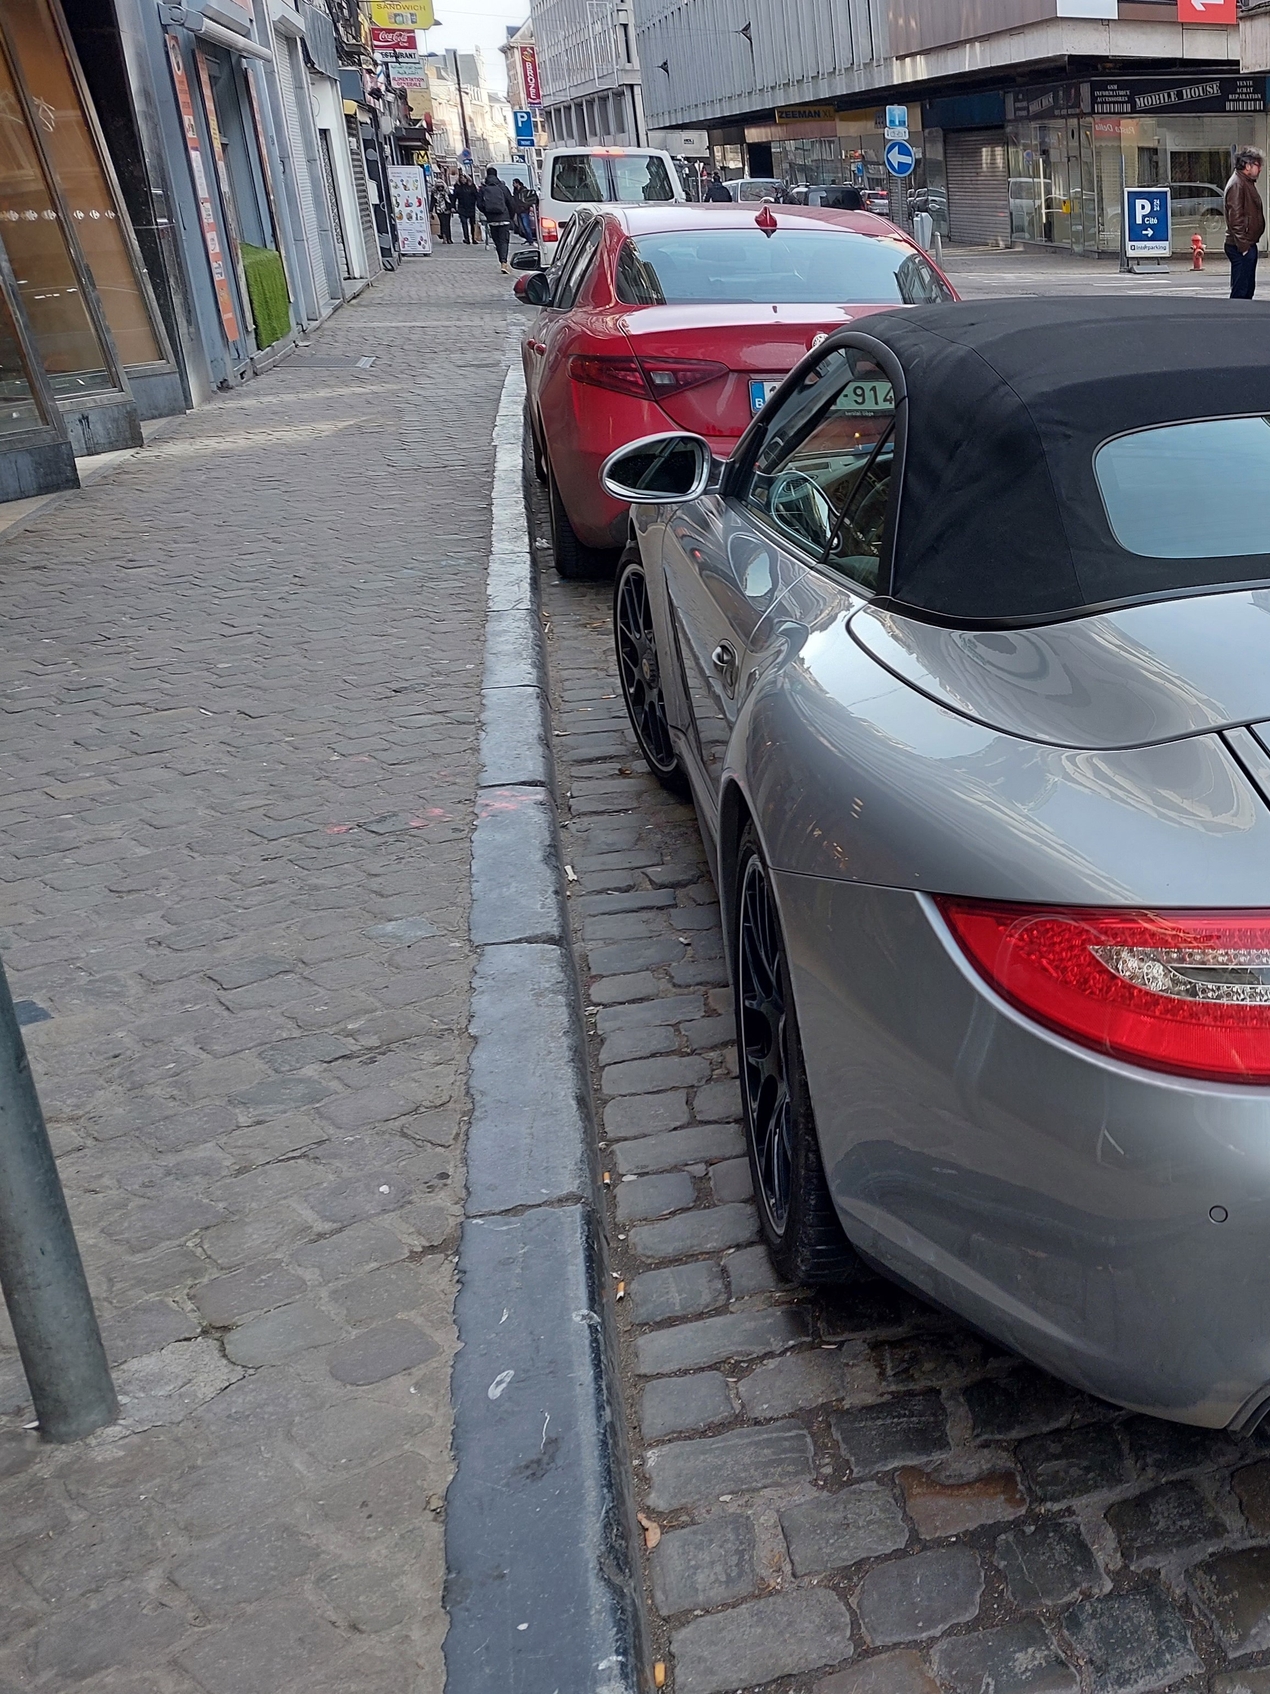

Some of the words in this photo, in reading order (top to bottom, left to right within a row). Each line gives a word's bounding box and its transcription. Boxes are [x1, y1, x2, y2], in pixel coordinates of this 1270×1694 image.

[376, 3, 426, 11] SANDWICH
[379, 30, 408, 42] Coca-Cola
[526, 62, 537, 99] BROZE
[1135, 90, 1178, 109] MOBILE
[1182, 82, 1220, 99] HOUSE
[517, 112, 528, 127] P
[778, 110, 821, 119] ZEEMAN
[822, 109, 833, 117] XL
[1135, 199, 1151, 225] P
[755, 398, 763, 409] B
